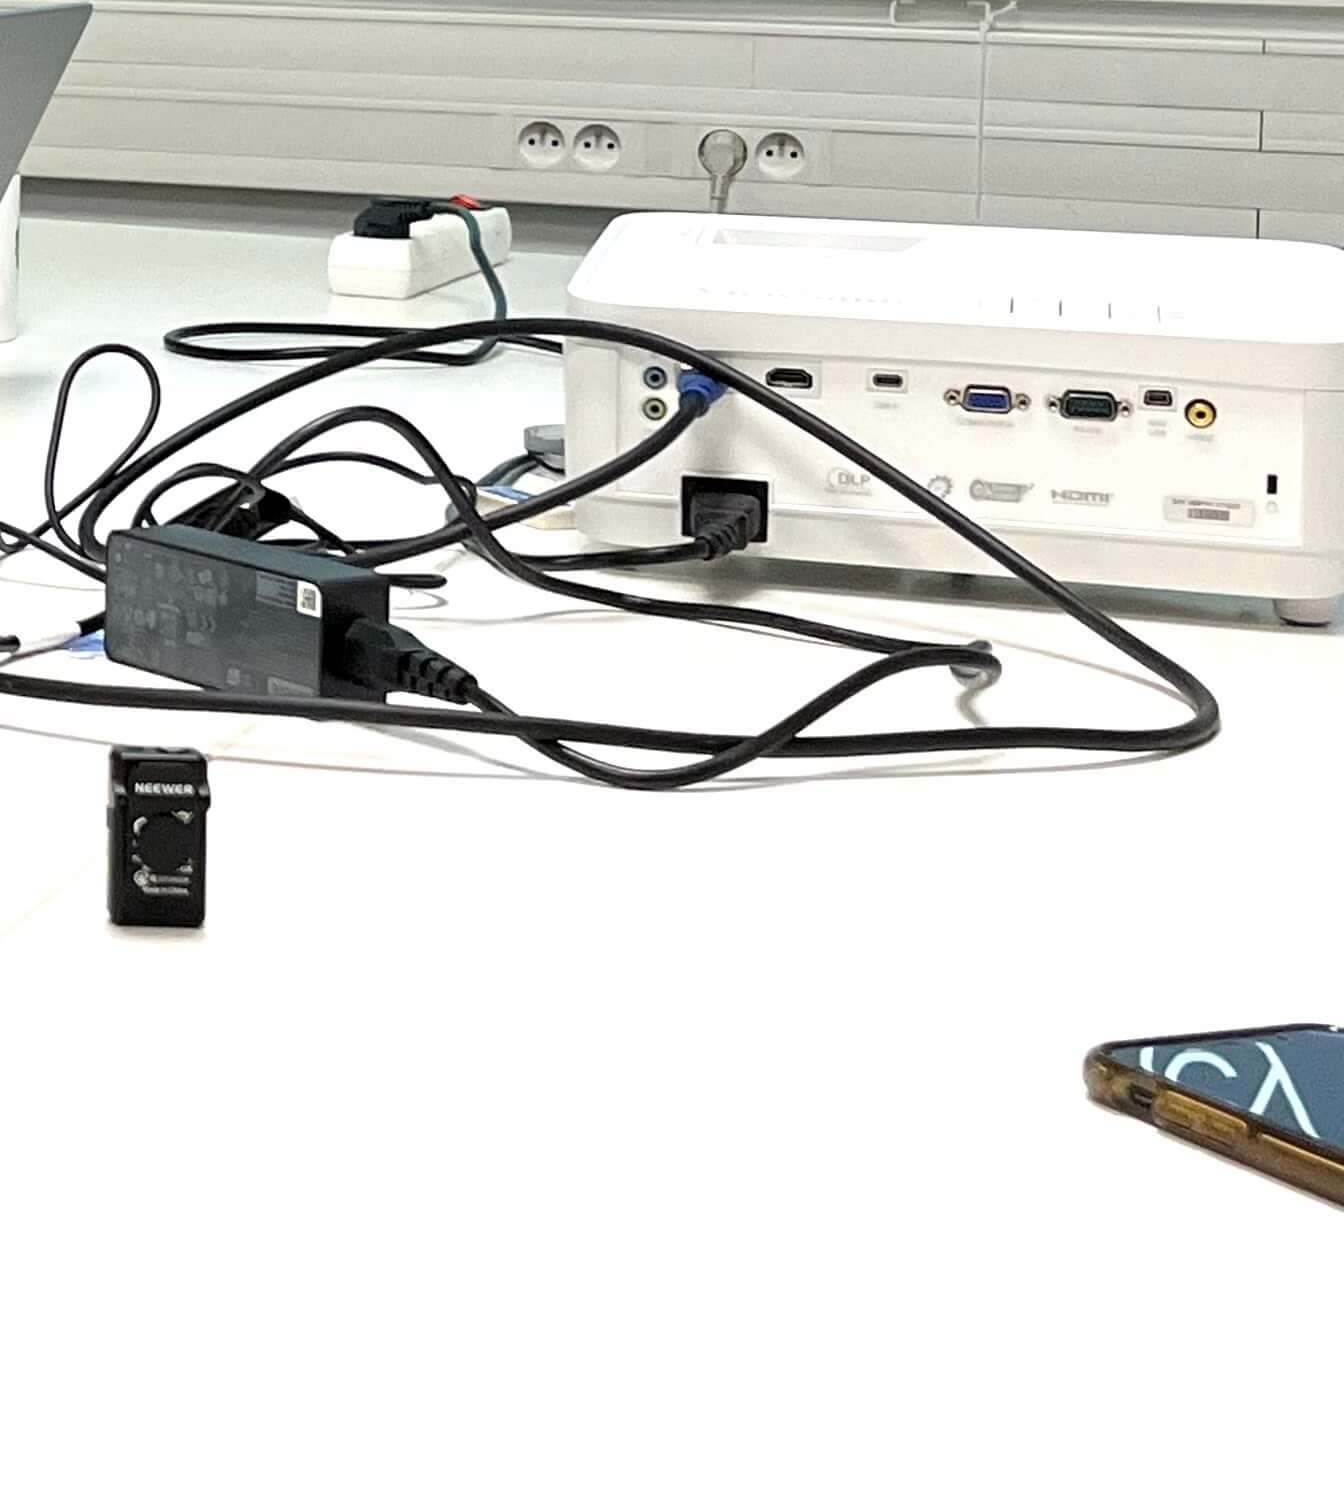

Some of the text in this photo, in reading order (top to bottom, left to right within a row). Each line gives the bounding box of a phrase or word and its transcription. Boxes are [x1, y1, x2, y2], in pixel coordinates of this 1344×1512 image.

[837, 471, 871, 487] DLP
[1050, 489, 1111, 503] HDMI
[134, 782, 194, 795] NEEWER
